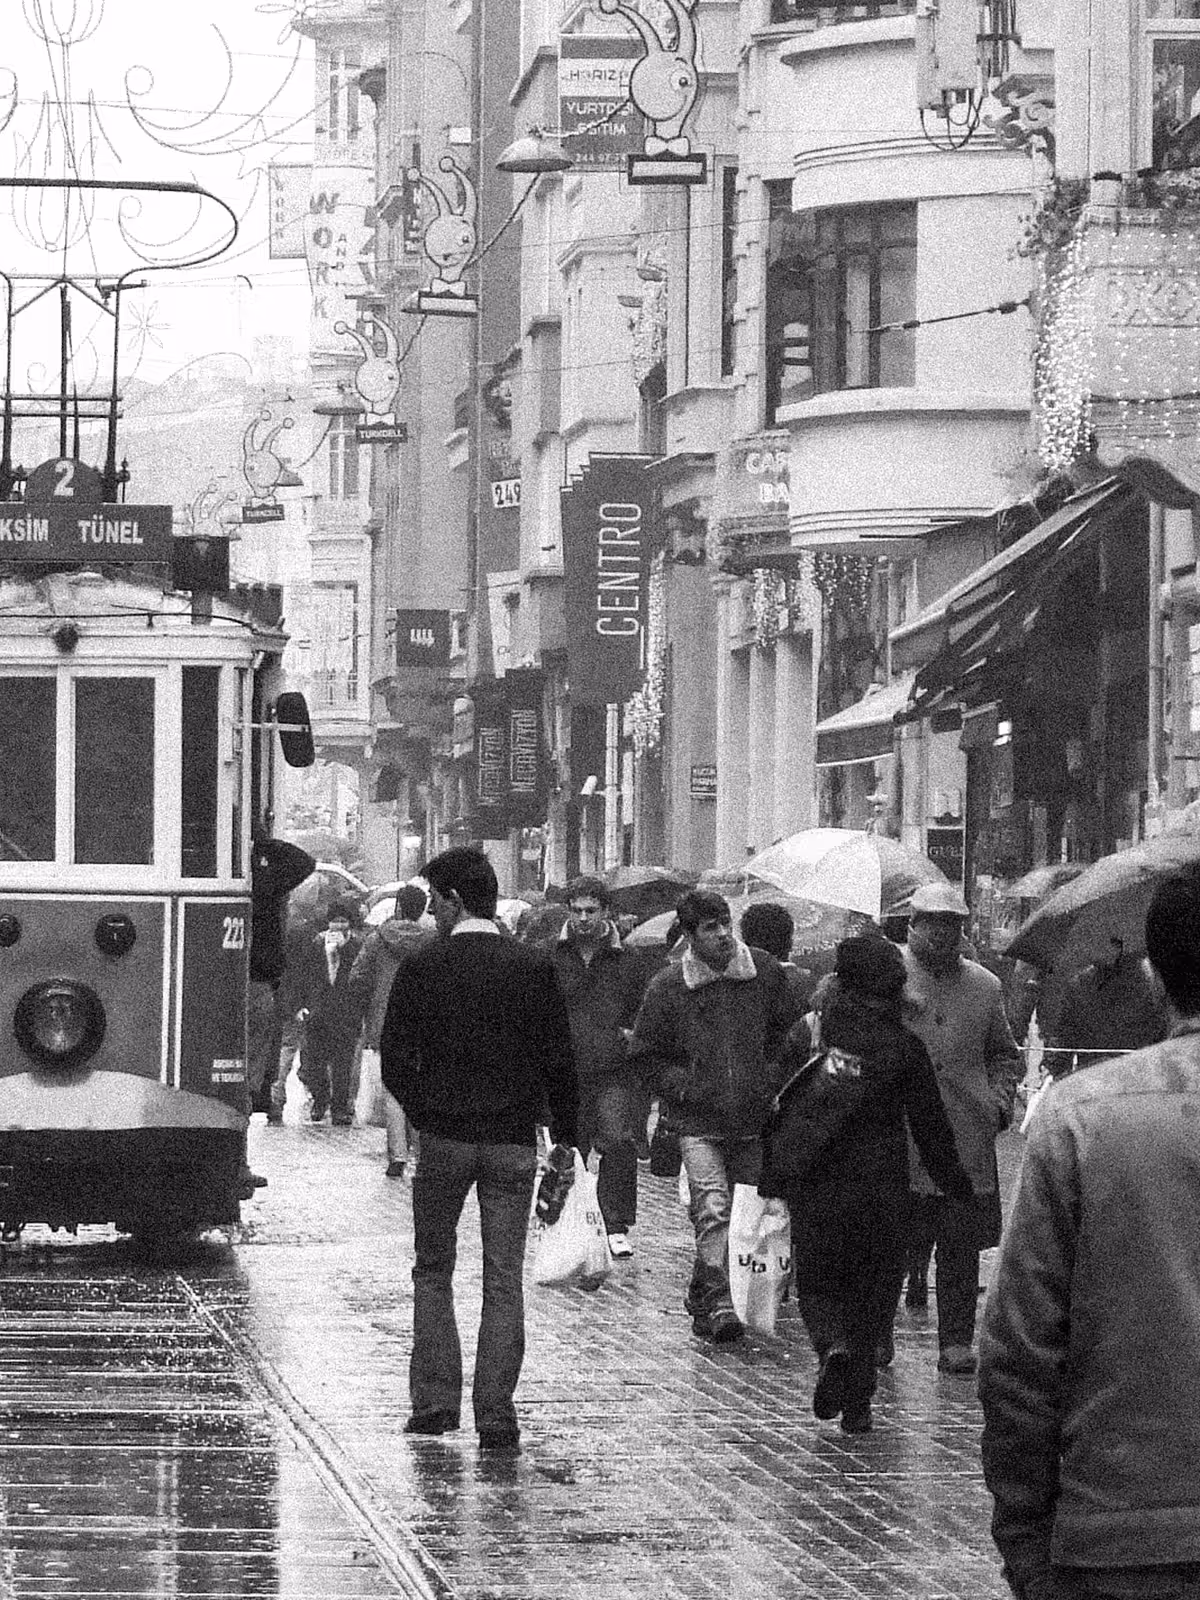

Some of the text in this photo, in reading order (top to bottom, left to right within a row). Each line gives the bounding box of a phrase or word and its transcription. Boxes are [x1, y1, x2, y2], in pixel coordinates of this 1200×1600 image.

[53, 460, 75, 497] 2
[78, 514, 144, 545] TÜNEL
[596, 502, 642, 635] CENTRO
